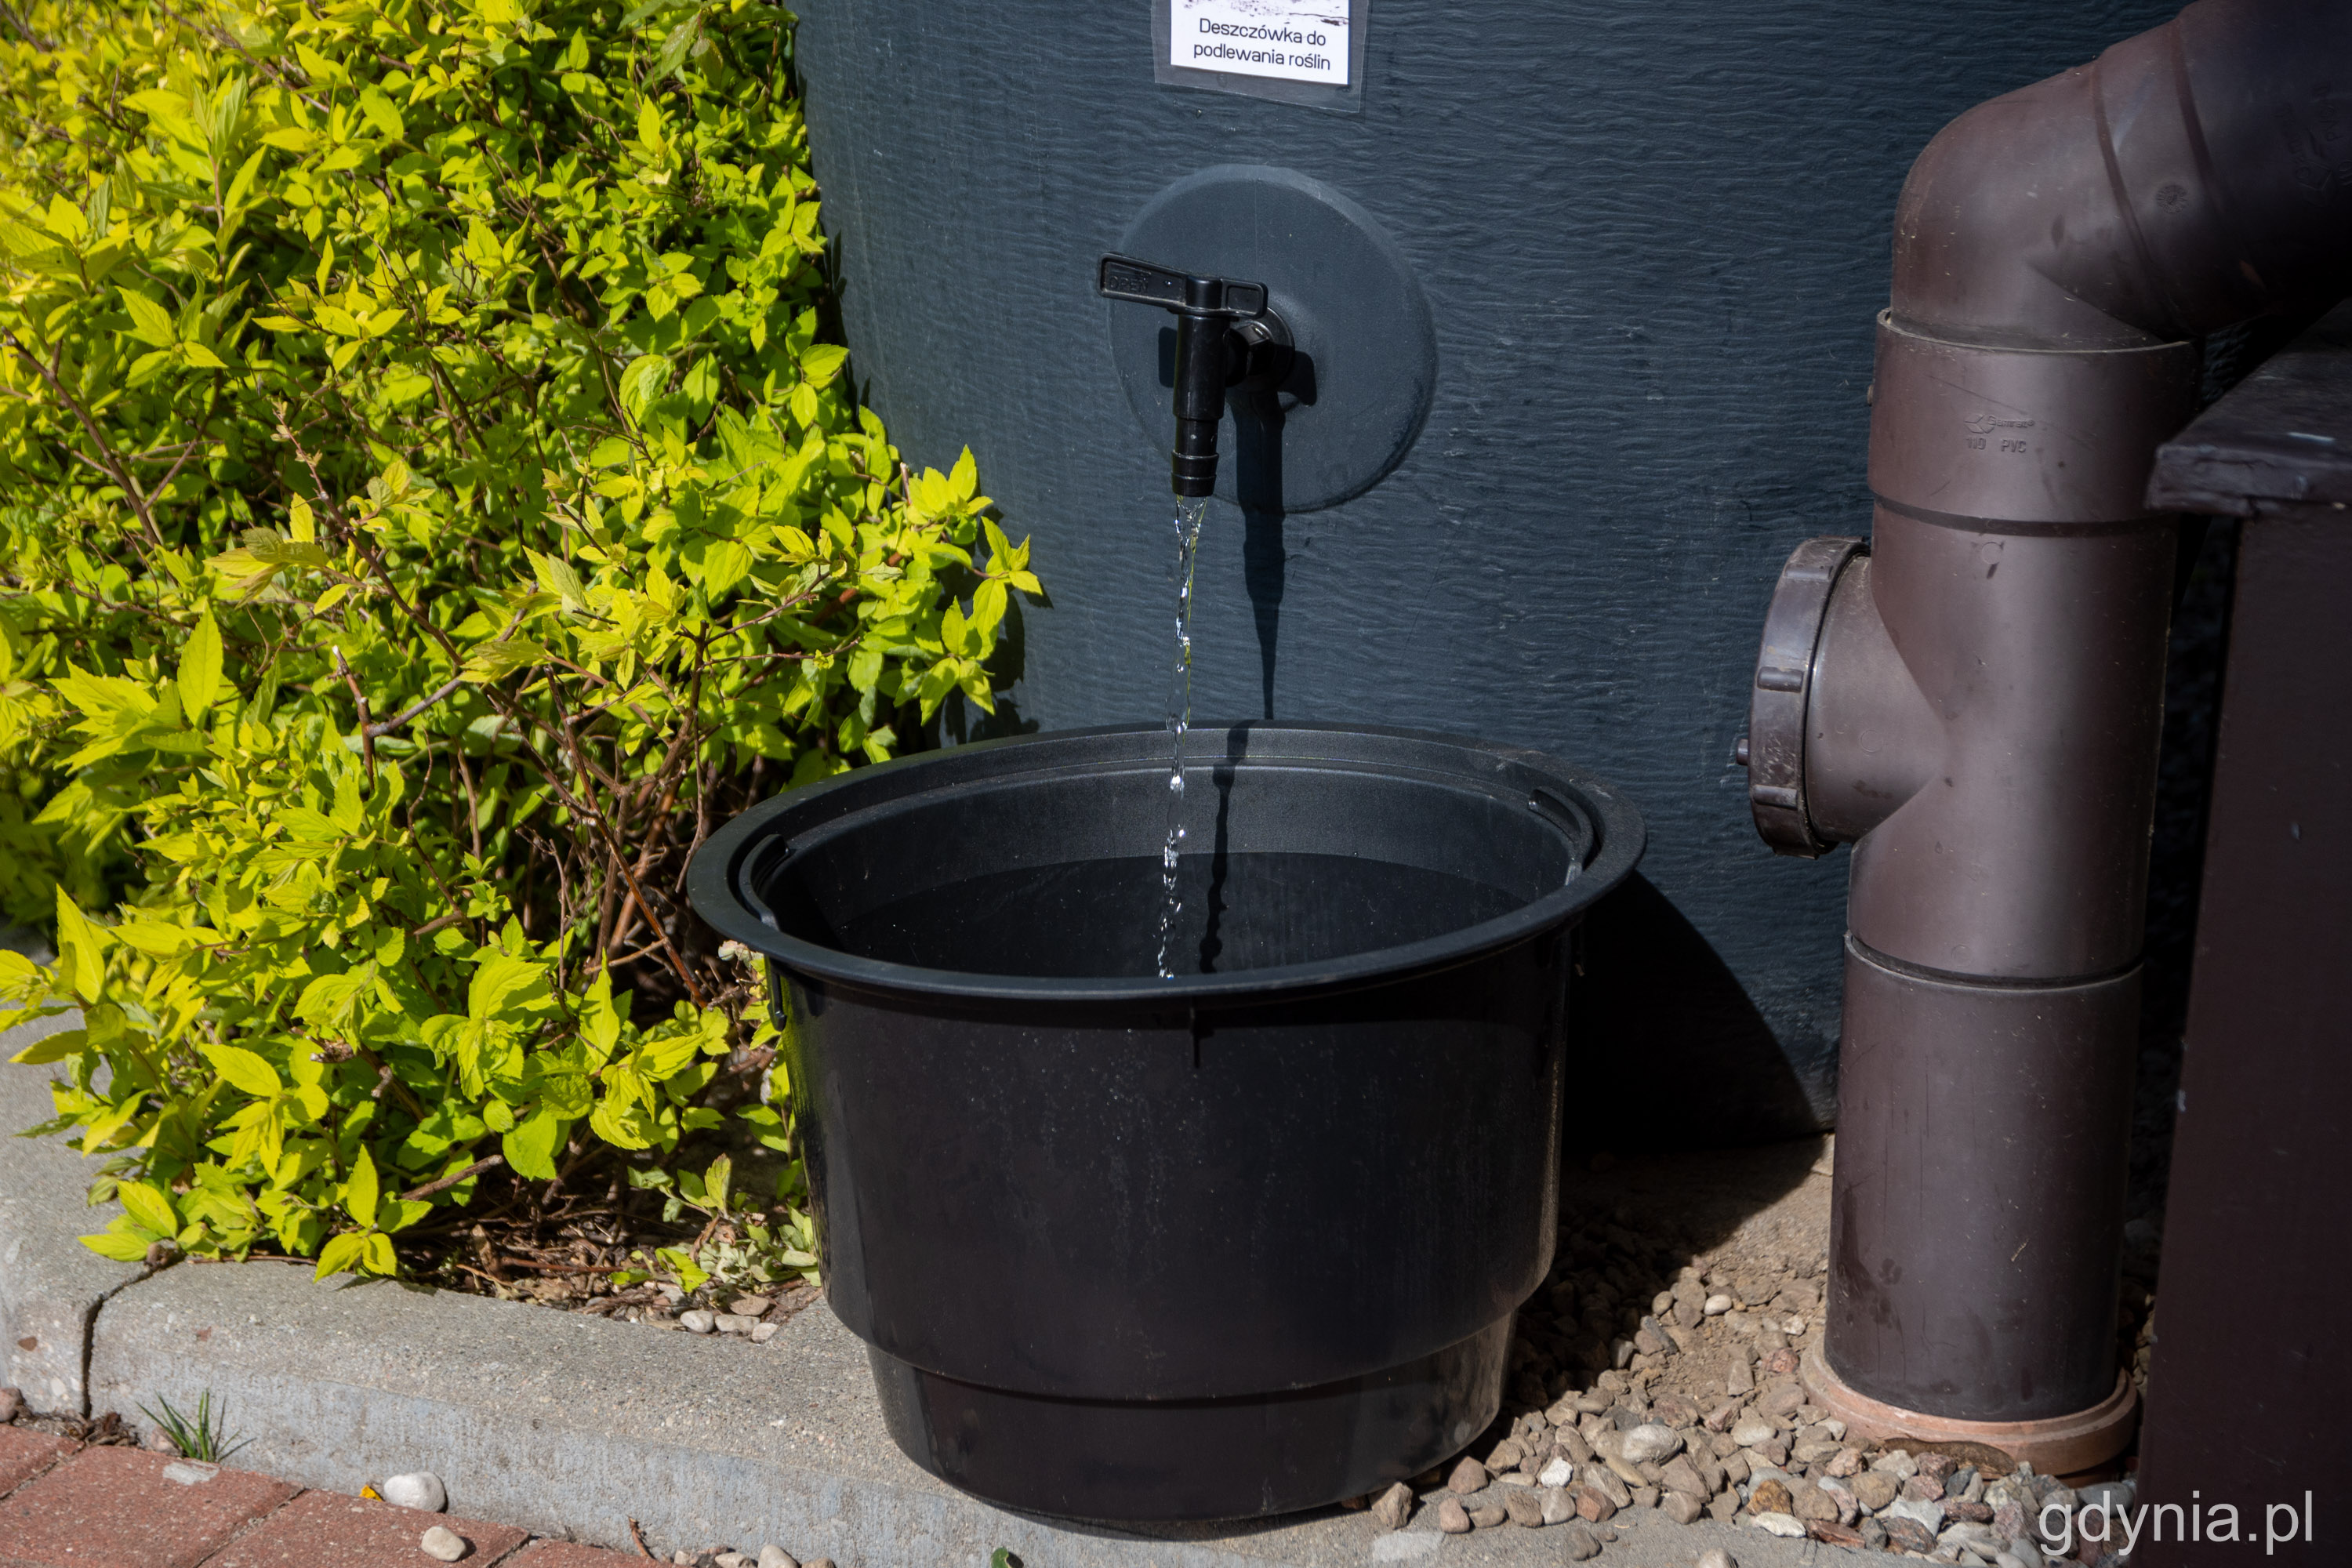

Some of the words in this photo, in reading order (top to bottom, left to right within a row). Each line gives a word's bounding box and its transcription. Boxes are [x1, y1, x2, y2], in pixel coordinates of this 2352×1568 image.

[1200, 18, 1303, 44] Deszczówka
[1306, 30, 1327, 46] do
[1193, 43, 1285, 65] podlewania
[1289, 53, 1330, 71] roślin
[1109, 275, 1149, 295] OPEN
[2000, 438, 2027, 453] PVC
